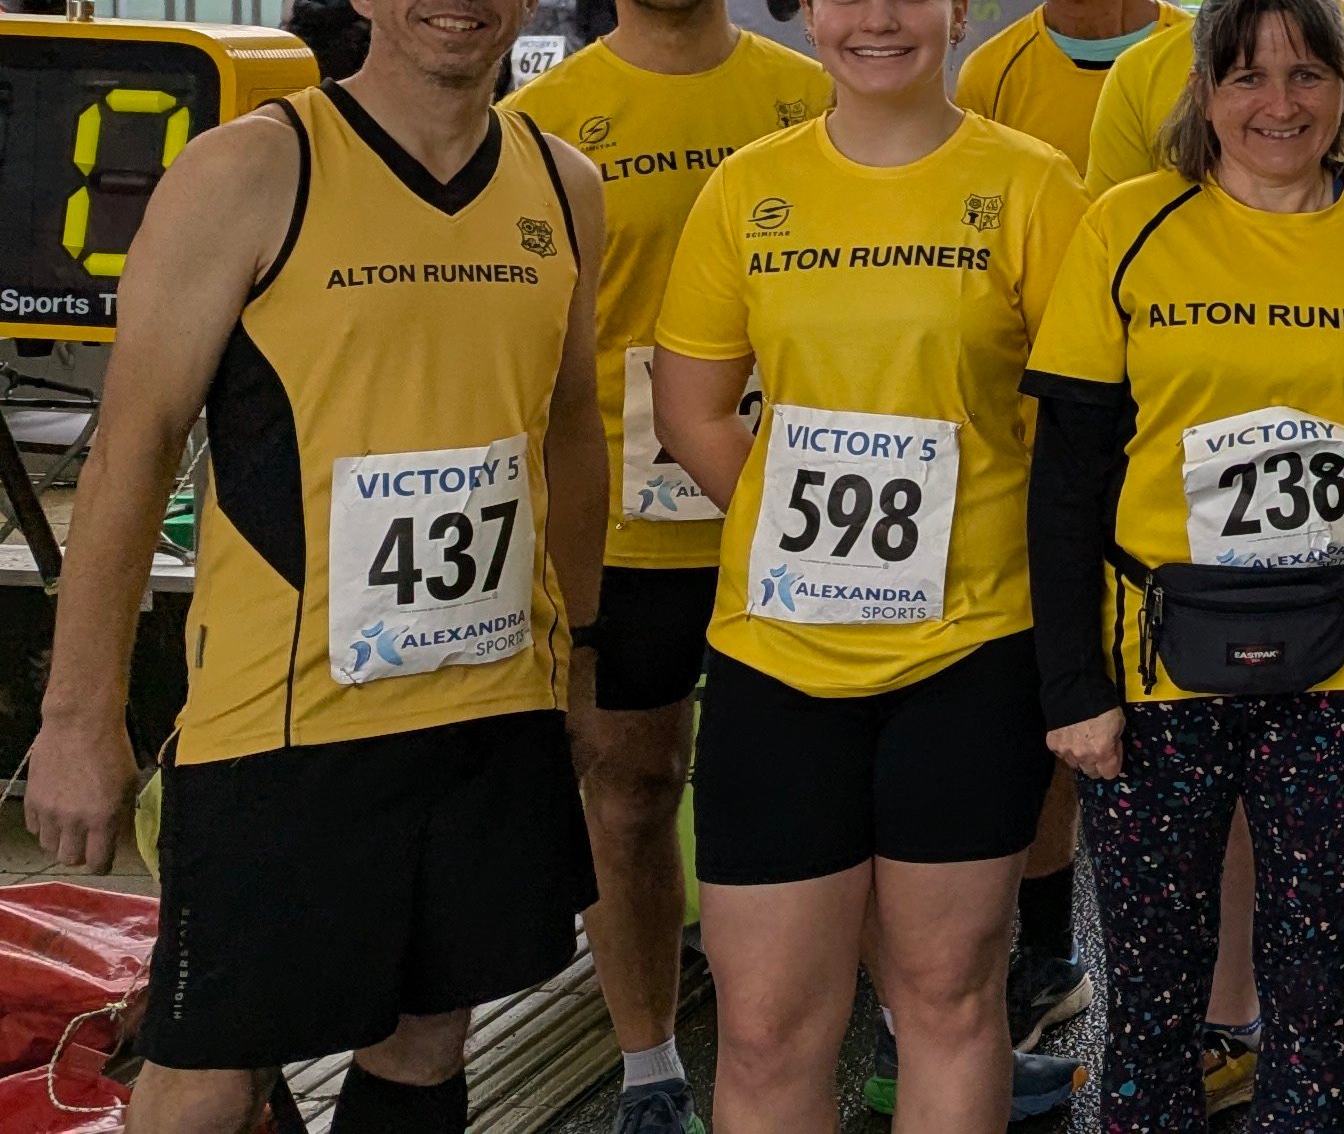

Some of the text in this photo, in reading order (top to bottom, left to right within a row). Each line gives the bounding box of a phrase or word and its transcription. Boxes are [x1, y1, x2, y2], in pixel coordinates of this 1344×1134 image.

[520, 52, 556, 73] 627
[601, 151, 677, 183] LTON
[748, 245, 991, 276] ALTON RUNNERS
[326, 264, 539, 290] ALTON RUNNERS
[1, 288, 90, 316] Sports
[1149, 302, 1257, 329] ALTON
[787, 423, 938, 463] VICTORY 5
[1206, 420, 1335, 453] VICTORY
[507, 455, 519, 481] 5
[778, 468, 922, 562] 598
[367, 498, 519, 605] 437
[795, 583, 928, 603] ALEXANDRA
[861, 606, 927, 619] SPORTS
[401, 610, 526, 649] ALEXANDRA
[476, 628, 525, 657] SPORTS
[1234, 650, 1276, 660] EASTPAK
